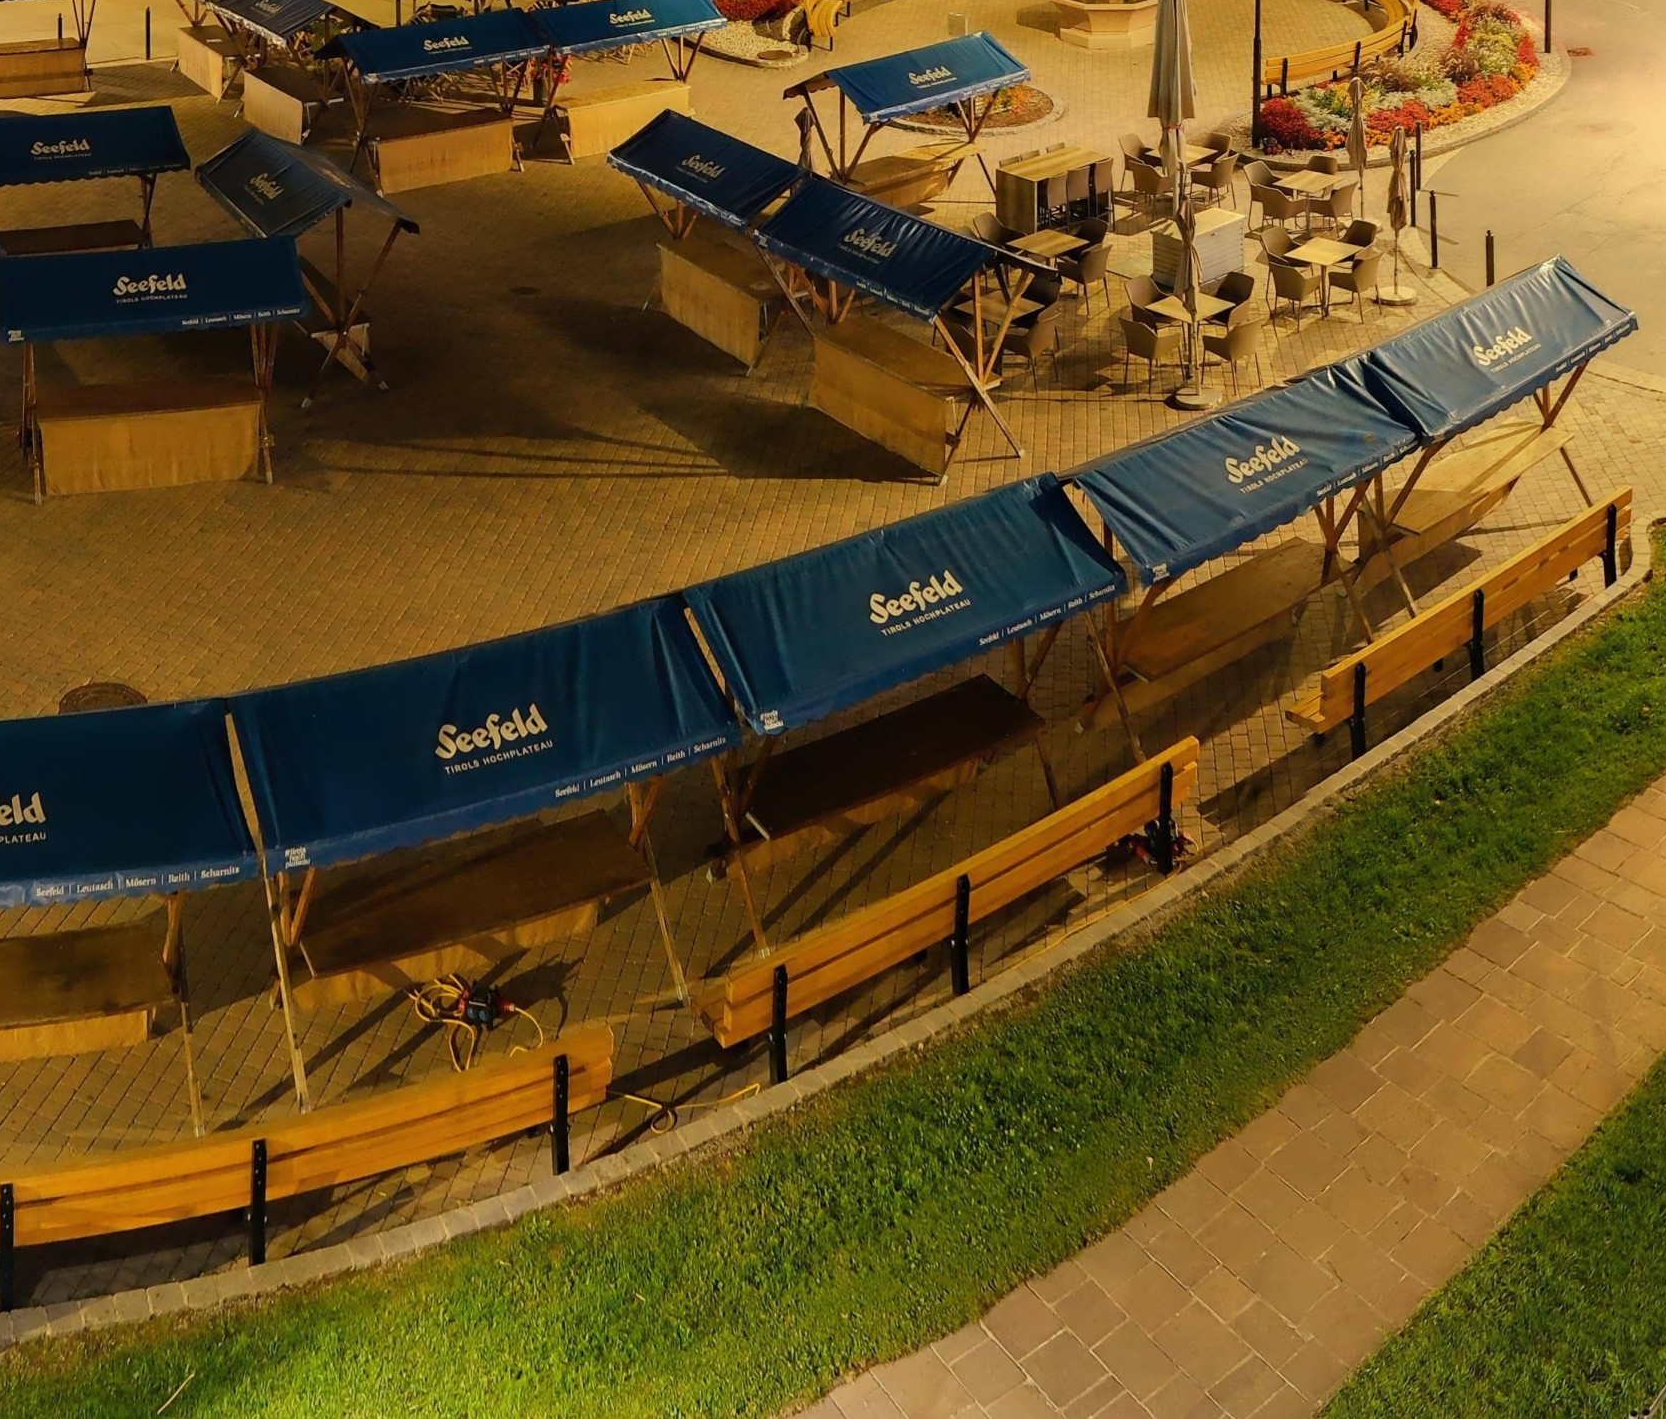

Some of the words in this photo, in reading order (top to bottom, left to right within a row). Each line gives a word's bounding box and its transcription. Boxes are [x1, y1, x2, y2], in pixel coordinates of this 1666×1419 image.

[609, 8, 652, 25] Seefeld
[423, 35, 469, 52] Seefeld
[908, 65, 952, 85] Seefeld
[30, 138, 91, 155] Seefeld
[681, 154, 726, 179] Seefeld
[843, 227, 898, 258] Seefeld
[113, 273, 188, 296] Seefeld
[1473, 326, 1533, 367] Seefeld
[1225, 435, 1301, 484] Seefeld
[869, 569, 964, 625] Seefeld
[880, 621, 913, 638] TIROLS
[913, 598, 972, 627] HOCHPLATEAU
[435, 702, 549, 759] Seefeld
[444, 754, 480, 775] TIROLS
[483, 739, 555, 765] HOCHPLATEAU
[555, 783, 581, 798] Seefeld
[590, 771, 622, 788] Leutasch
[667, 750, 687, 764] Reith
[693, 737, 728, 755] Scharnitz
[35, 884, 65, 898] Seefeld
[76, 881, 114, 894] Leutasch
[168, 872, 191, 883] Reith
[201, 866, 241, 880] Scharnitz
